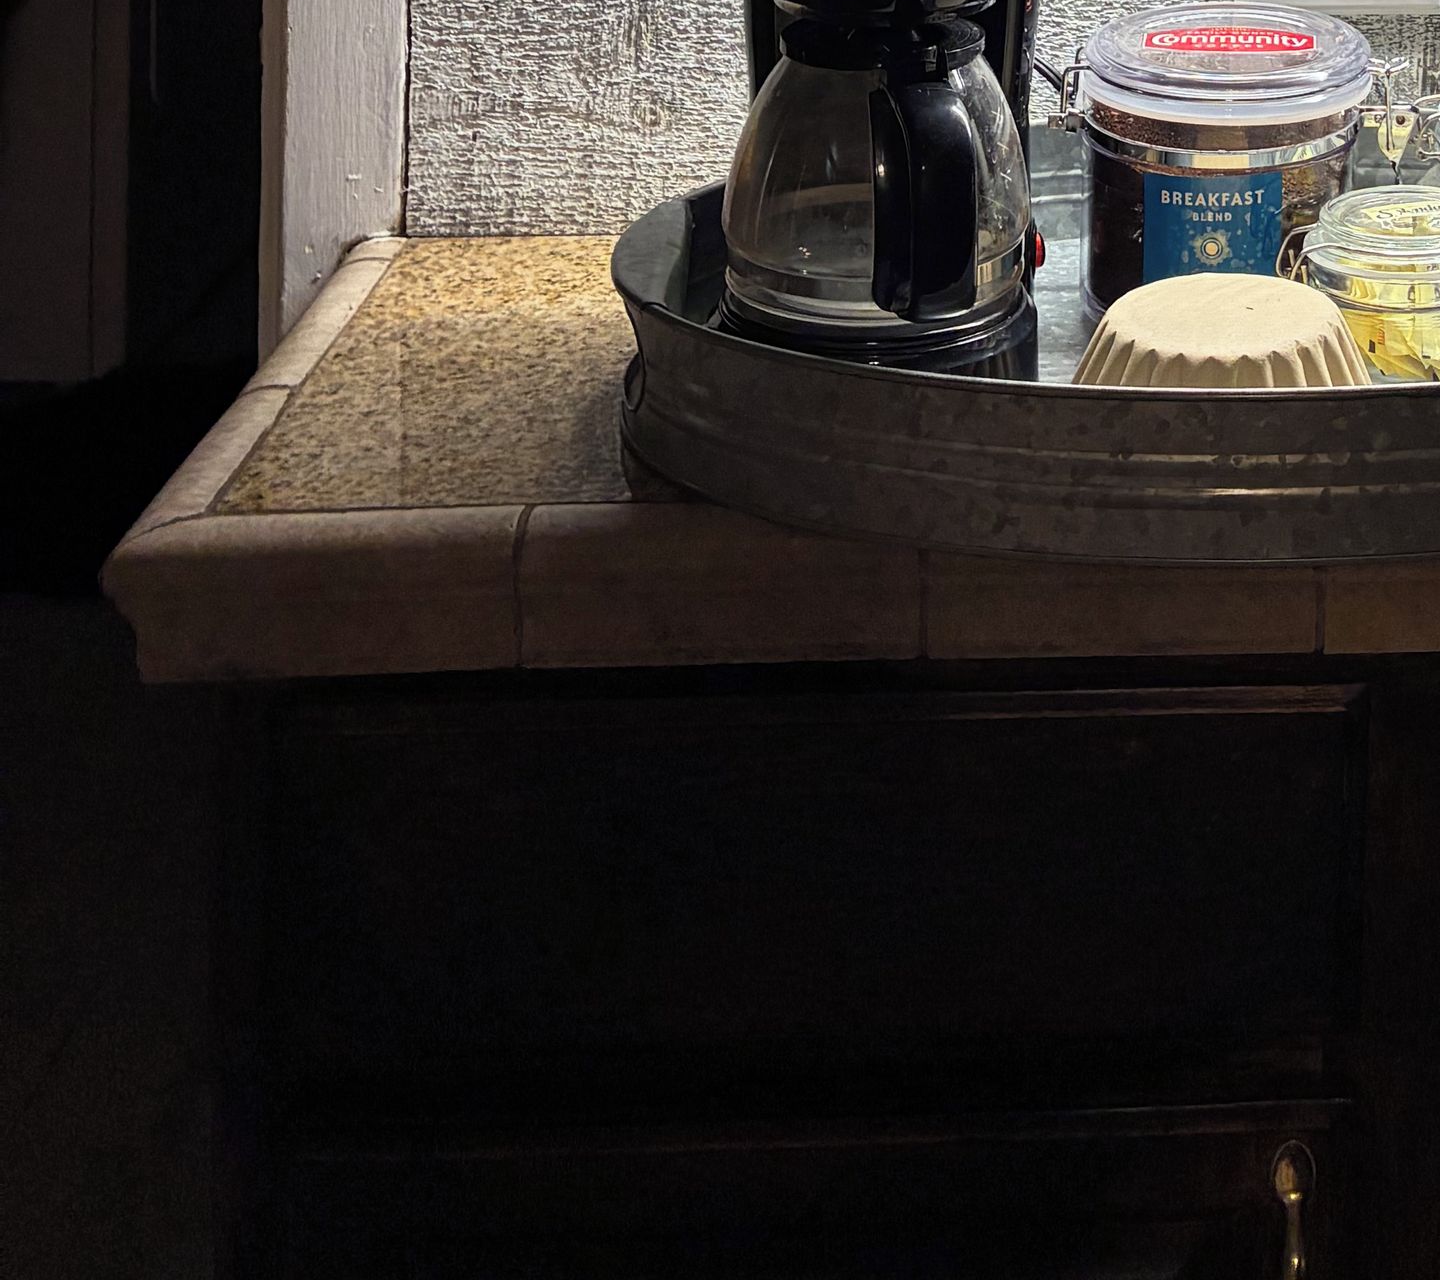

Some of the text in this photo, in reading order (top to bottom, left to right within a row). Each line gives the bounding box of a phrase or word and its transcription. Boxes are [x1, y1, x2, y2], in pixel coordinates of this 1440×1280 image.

[1151, 33, 1308, 47] Community
[1160, 189, 1265, 207] BREAKFAST
[1192, 211, 1233, 223] BLEND
